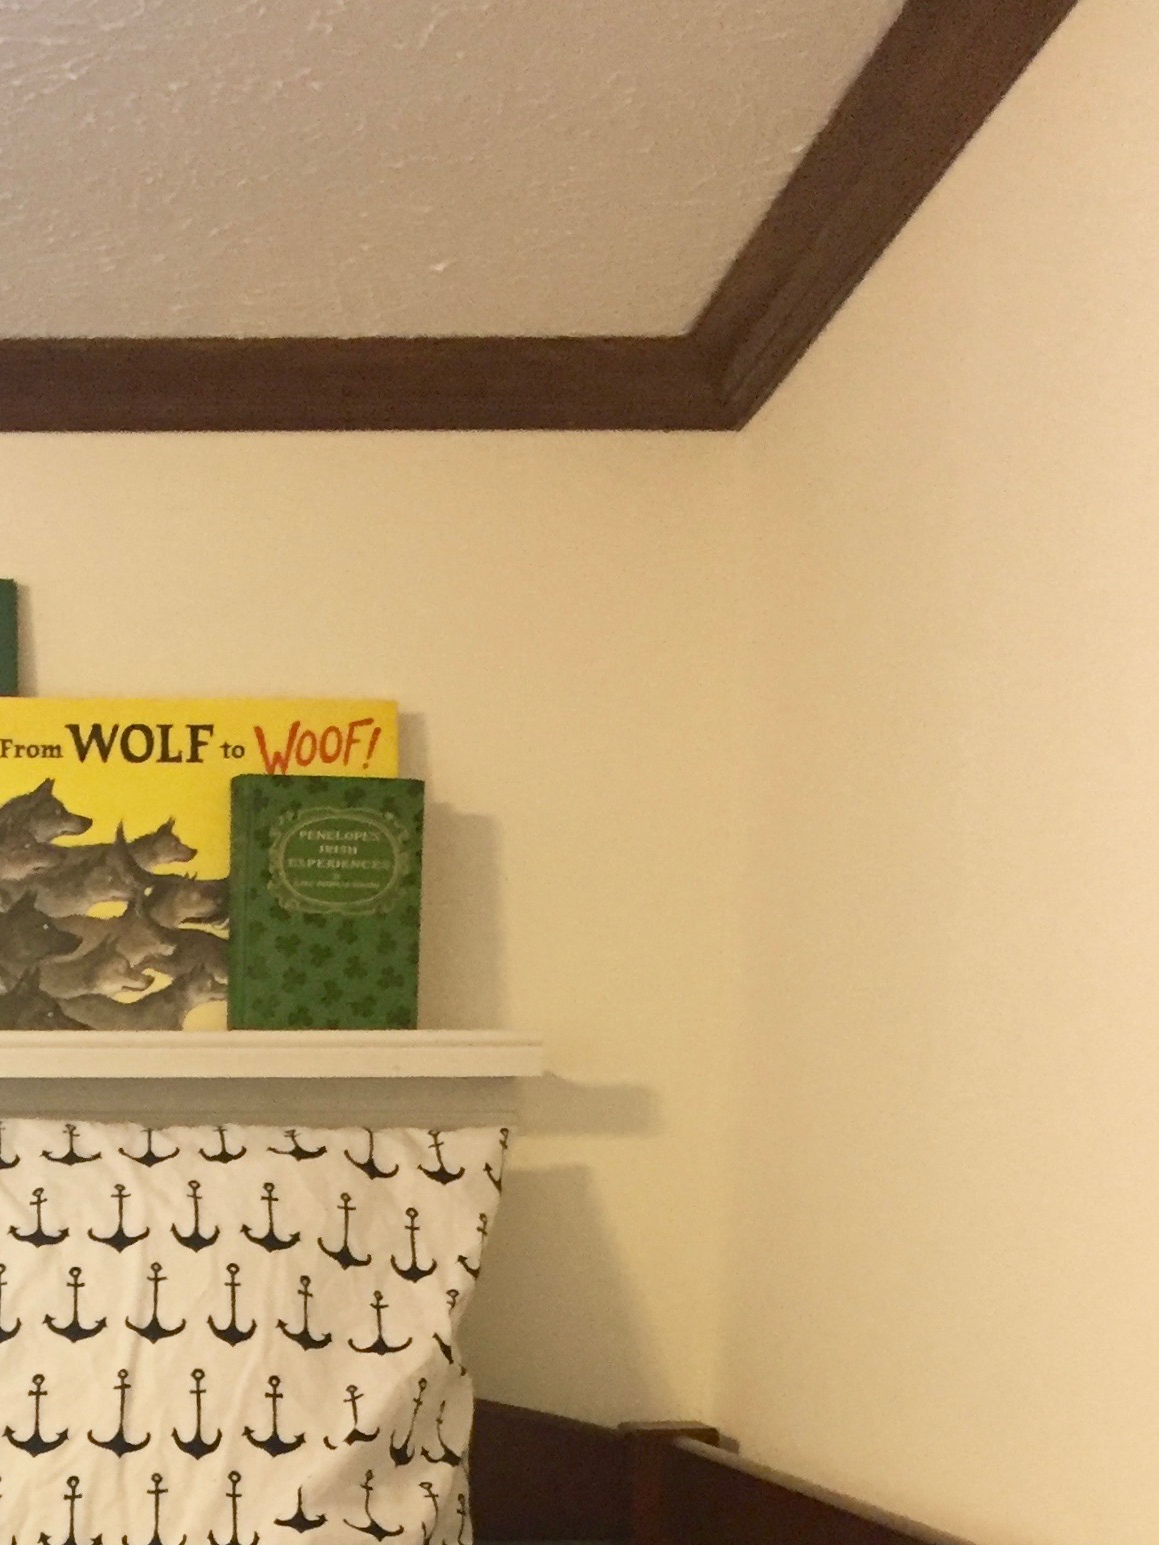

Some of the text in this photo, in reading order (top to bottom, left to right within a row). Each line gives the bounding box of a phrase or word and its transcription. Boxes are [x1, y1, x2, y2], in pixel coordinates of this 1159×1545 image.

[0, 717, 381, 775] From WOLF to WOOF!
